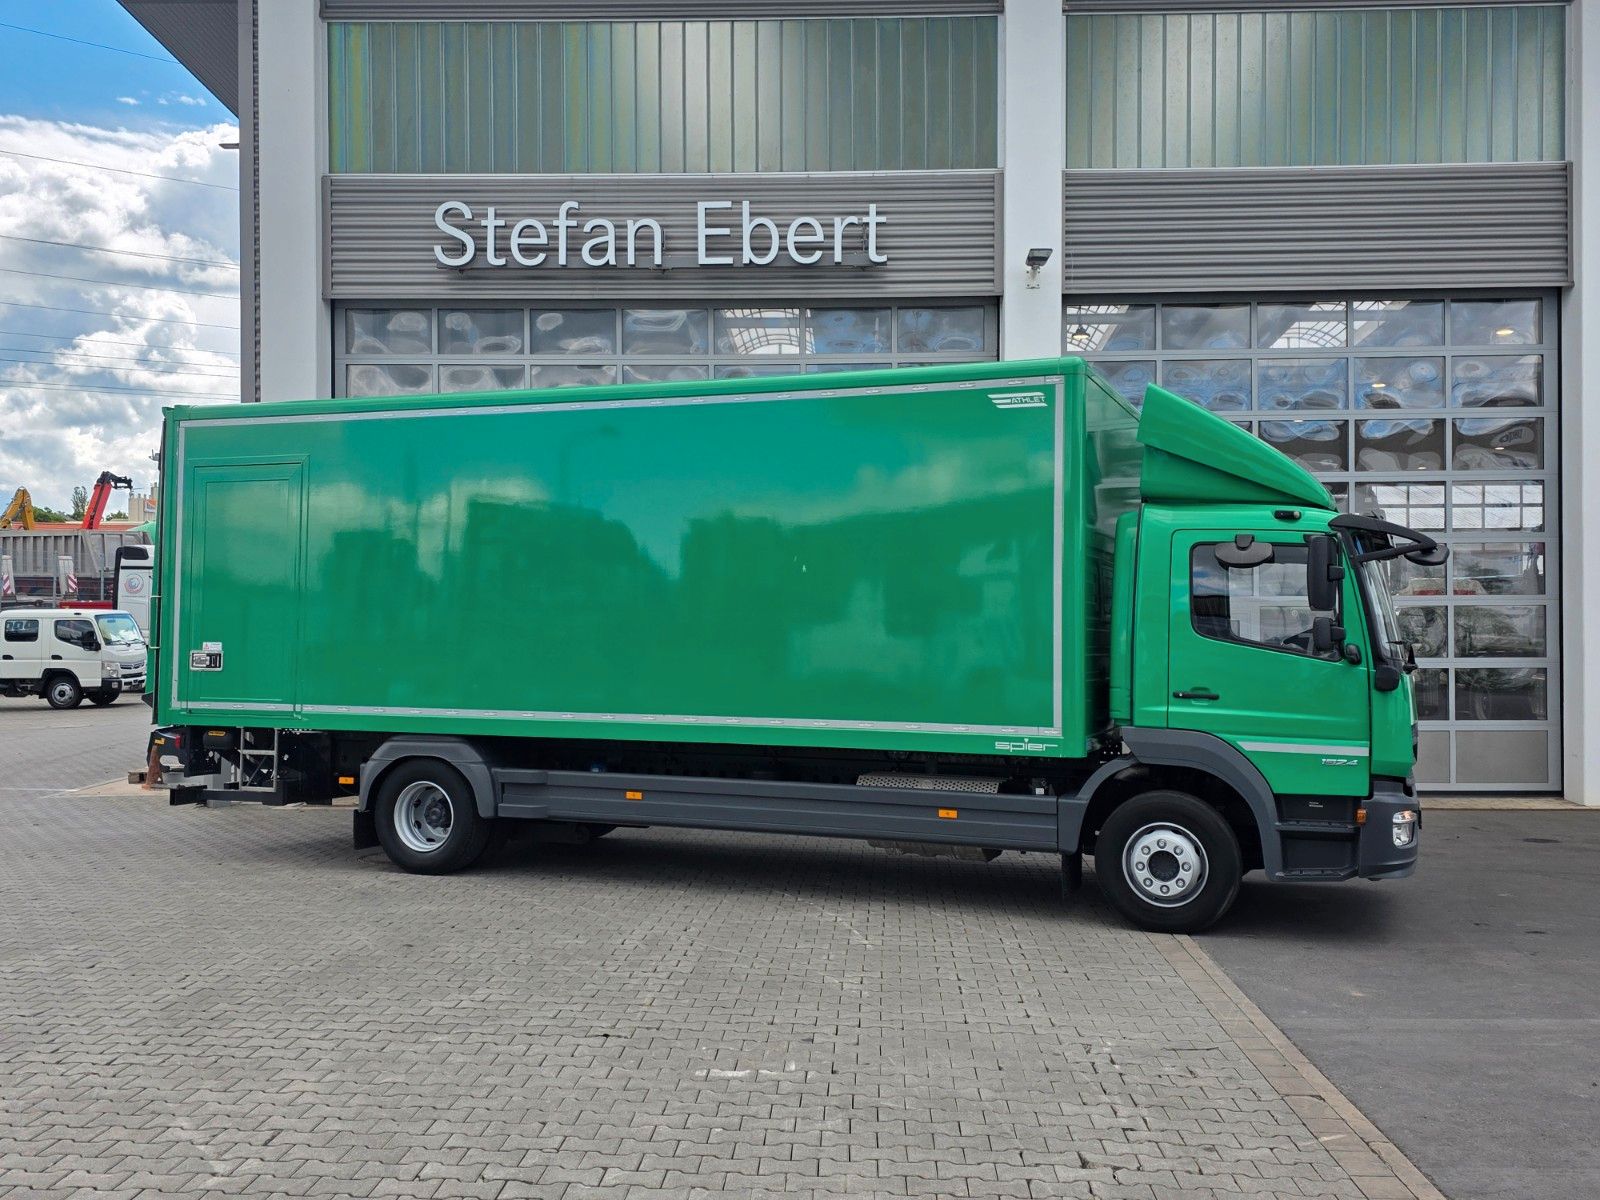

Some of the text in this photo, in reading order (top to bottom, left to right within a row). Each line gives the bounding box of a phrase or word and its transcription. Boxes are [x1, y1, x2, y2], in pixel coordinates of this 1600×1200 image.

[433, 200, 888, 267] Stefan Ebert
[1011, 396, 1046, 404] ATHLET
[995, 738, 1058, 752] spier
